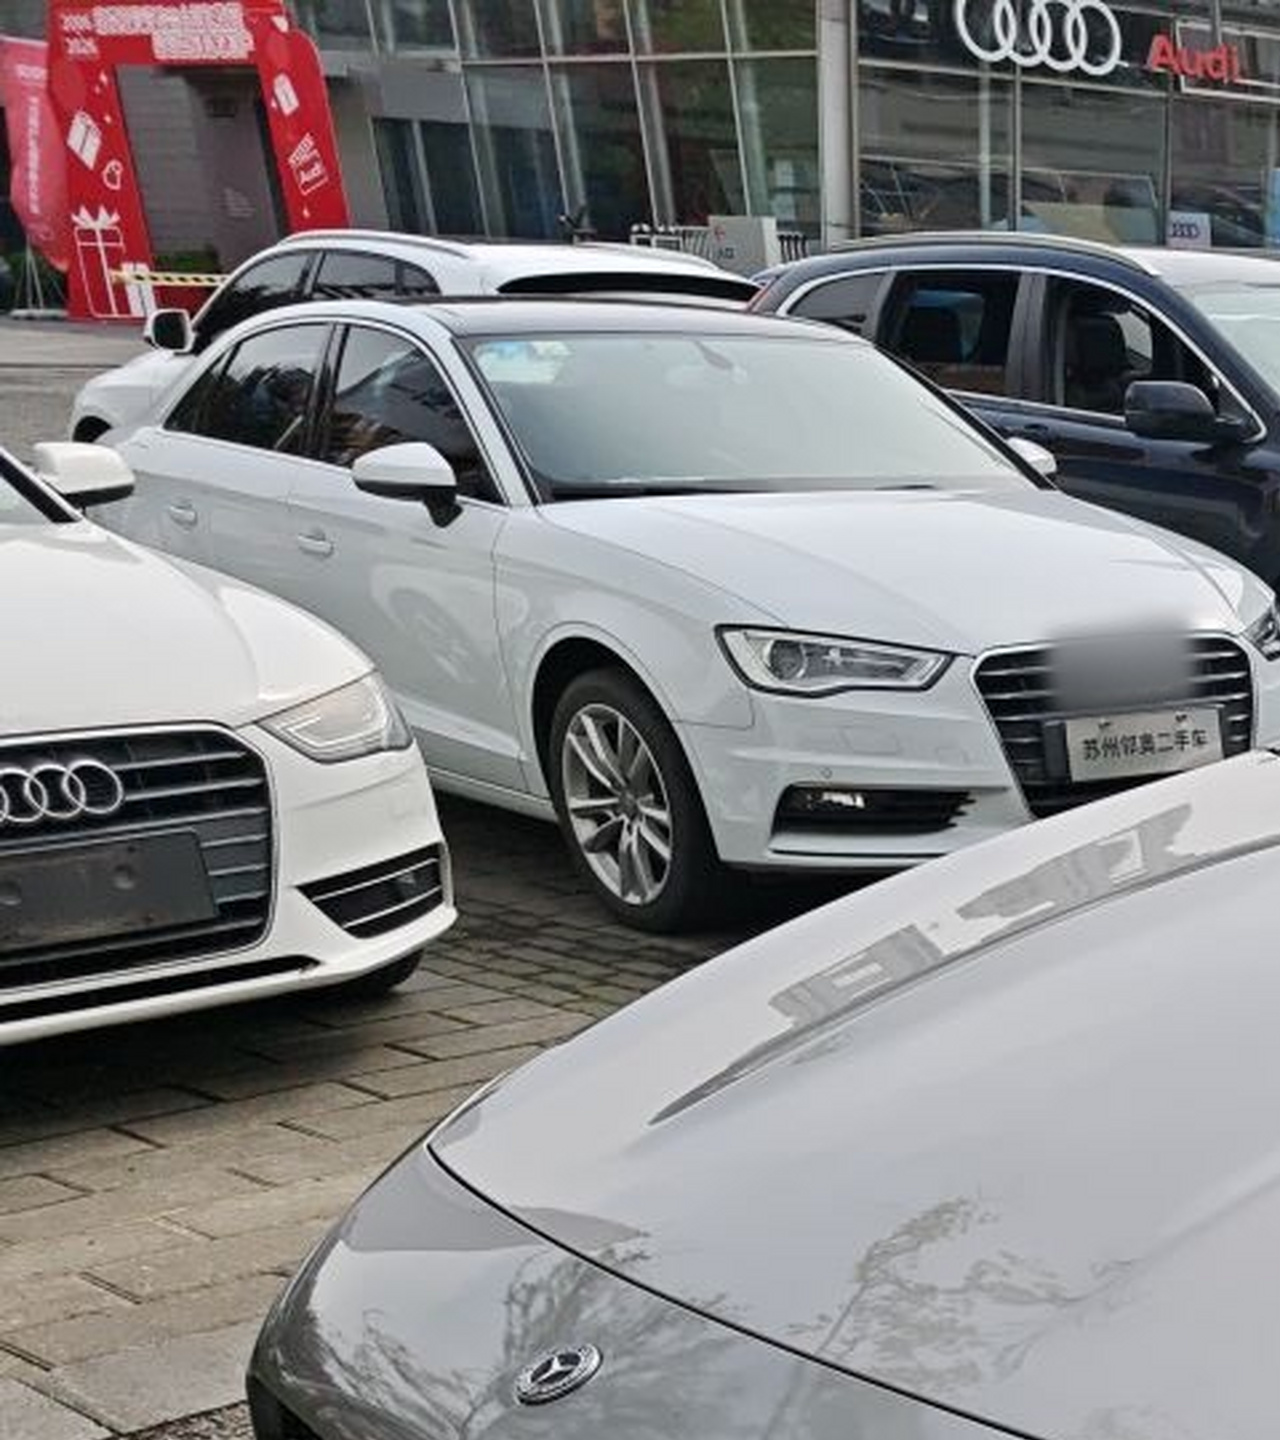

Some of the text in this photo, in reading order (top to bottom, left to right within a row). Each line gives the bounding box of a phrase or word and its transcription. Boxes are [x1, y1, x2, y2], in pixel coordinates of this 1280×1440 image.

[1147, 34, 1239, 83] Audi
[1083, 729, 1208, 761] 苏州邻奥二手车
